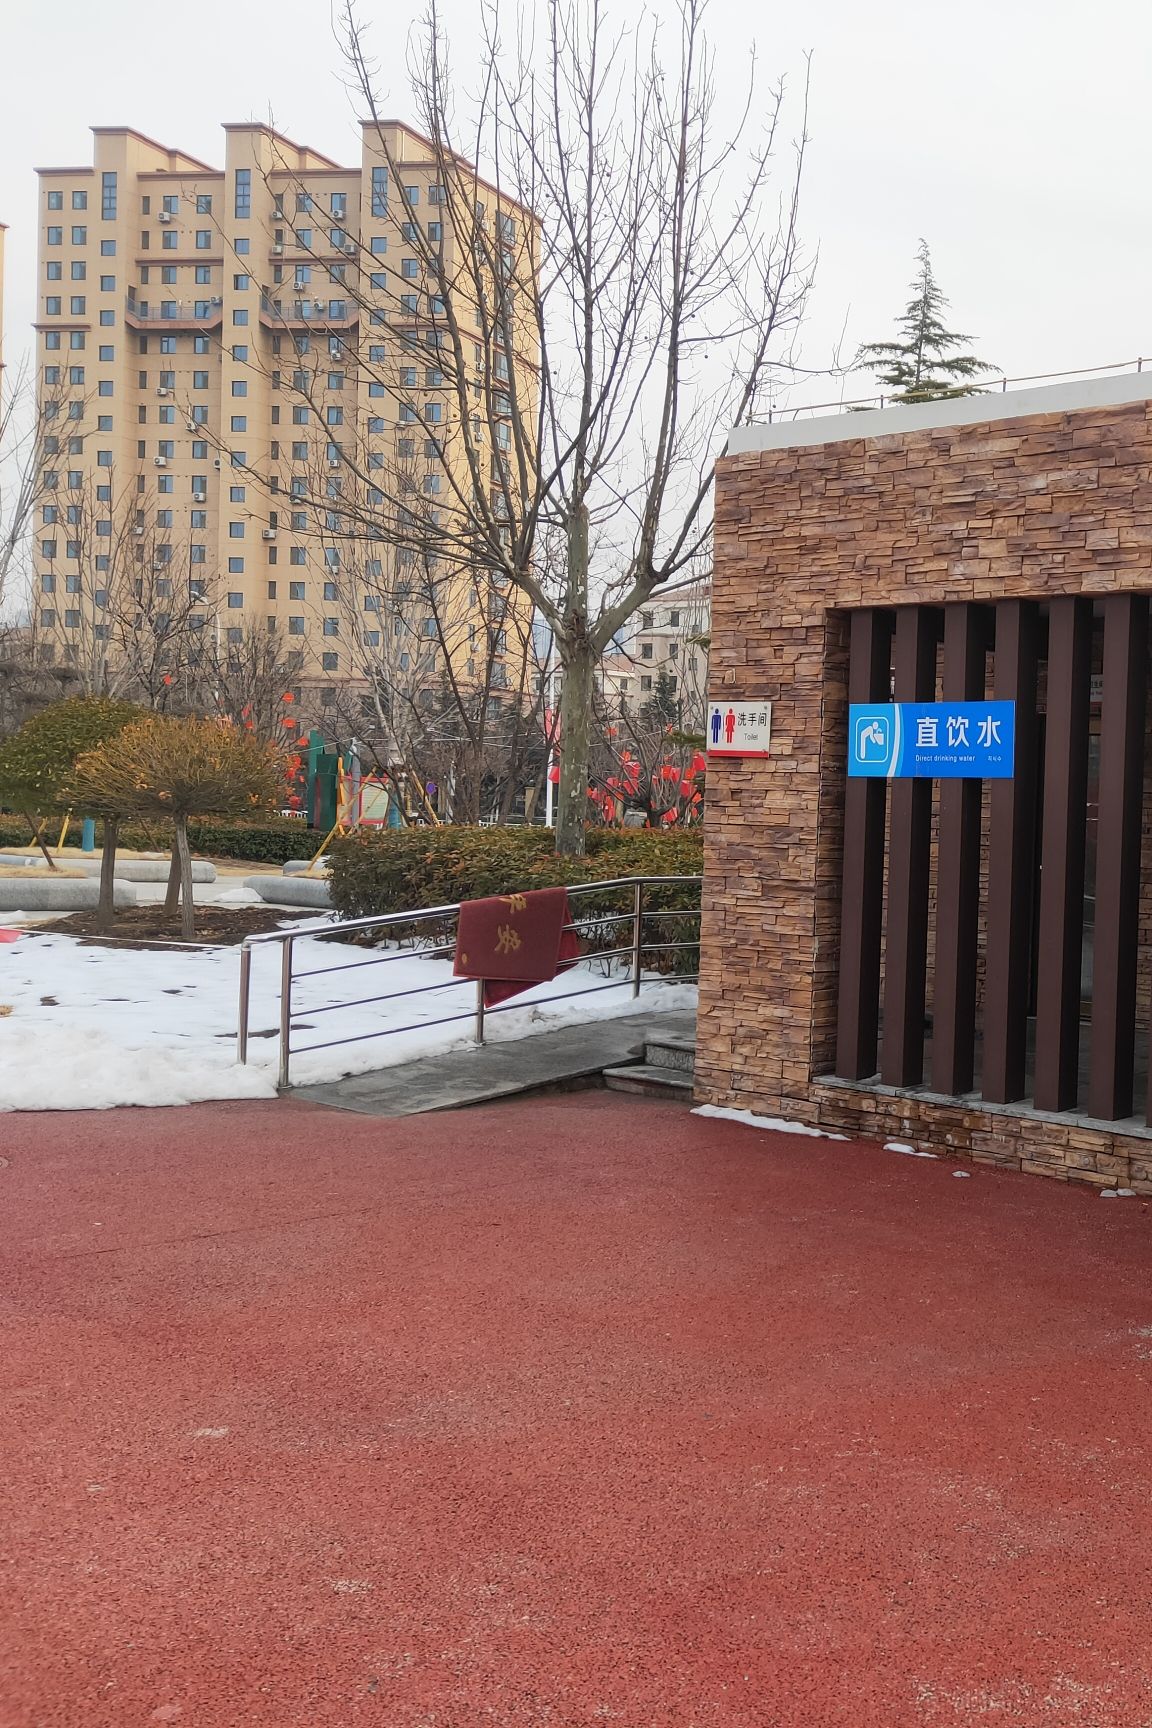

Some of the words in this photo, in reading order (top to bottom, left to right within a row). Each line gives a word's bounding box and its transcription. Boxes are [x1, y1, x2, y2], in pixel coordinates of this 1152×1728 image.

[737, 711, 767, 727] 洗手间
[743, 732, 759, 741] Toilet
[915, 715, 1002, 748] 直饮水
[915, 754, 933, 762] Direct
[934, 754, 957, 763] drinking
